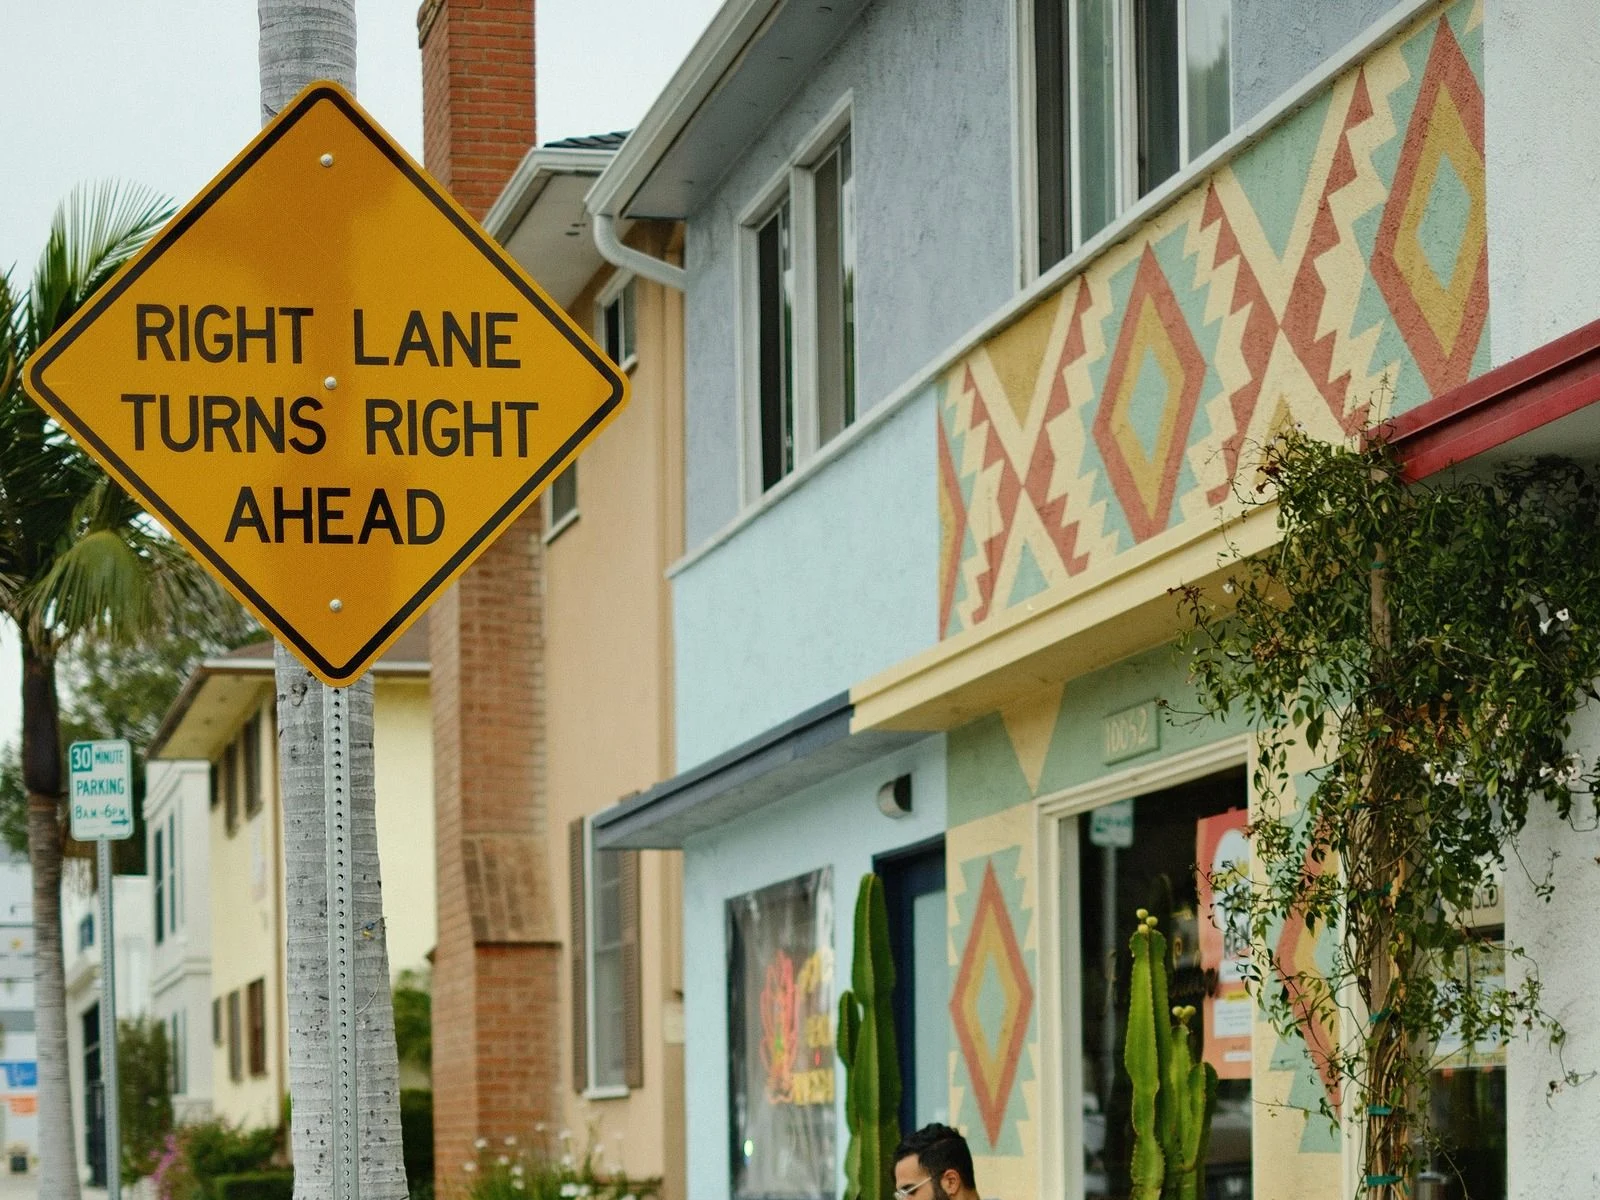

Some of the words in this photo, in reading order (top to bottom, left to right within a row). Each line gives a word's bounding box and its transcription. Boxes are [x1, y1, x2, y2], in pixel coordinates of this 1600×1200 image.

[136, 303, 314, 365] RIGHT
[353, 308, 522, 369] LANE
[120, 393, 327, 455] TURNS
[365, 398, 539, 458] RIGHT
[223, 485, 446, 546] AHEAD
[72, 747, 91, 769] 30
[95, 750, 124, 764] MINUTE
[76, 778, 125, 796] PARKING
